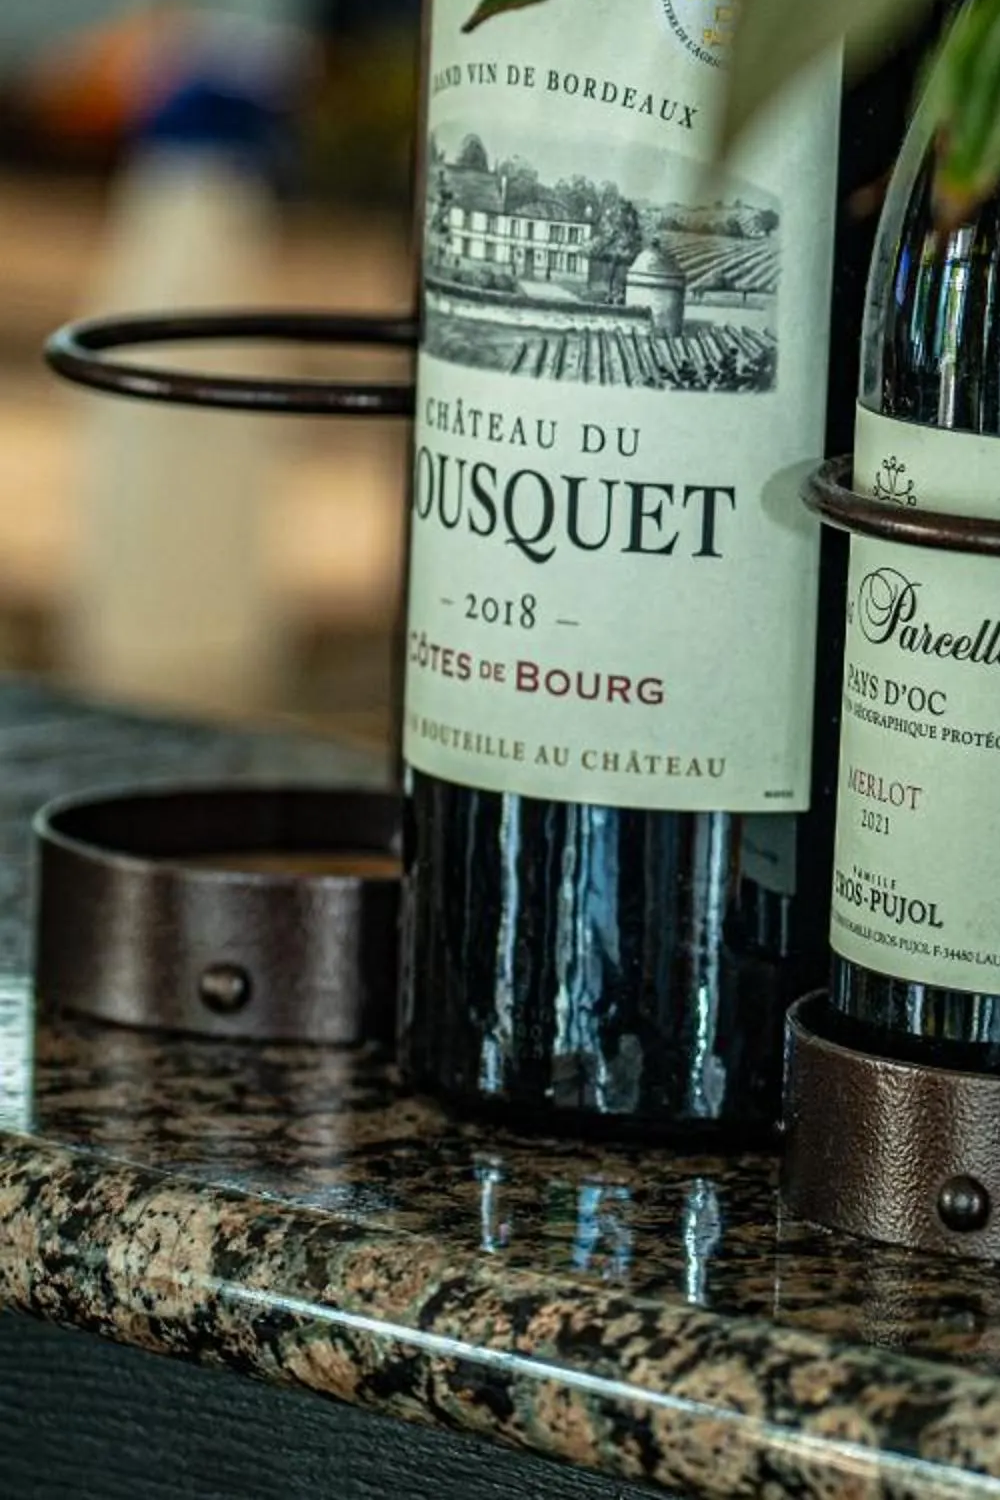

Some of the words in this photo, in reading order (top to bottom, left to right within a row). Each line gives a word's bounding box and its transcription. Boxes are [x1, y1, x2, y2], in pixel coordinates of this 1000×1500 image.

[466, 63, 497, 86] VIN
[506, 65, 536, 88] DE
[546, 68, 701, 130] BORDEAUX
[425, 398, 558, 450] CHÂTEAU
[581, 424, 641, 457] DU
[465, 593, 537, 630] 2018
[410, 631, 472, 682] CÔTES
[479, 660, 506, 683] DE
[516, 660, 665, 706] BOURG
[847, 663, 879, 700] PAYS
[884, 679, 948, 717] D'OC
[421, 718, 526, 762] BOUTEILLE
[534, 745, 570, 768] AU
[581, 745, 727, 778] CHÂTEAU
[848, 766, 923, 810] MERLOT
[860, 808, 891, 835] 2021
[835, 868, 944, 929] CROS-PUJOL
